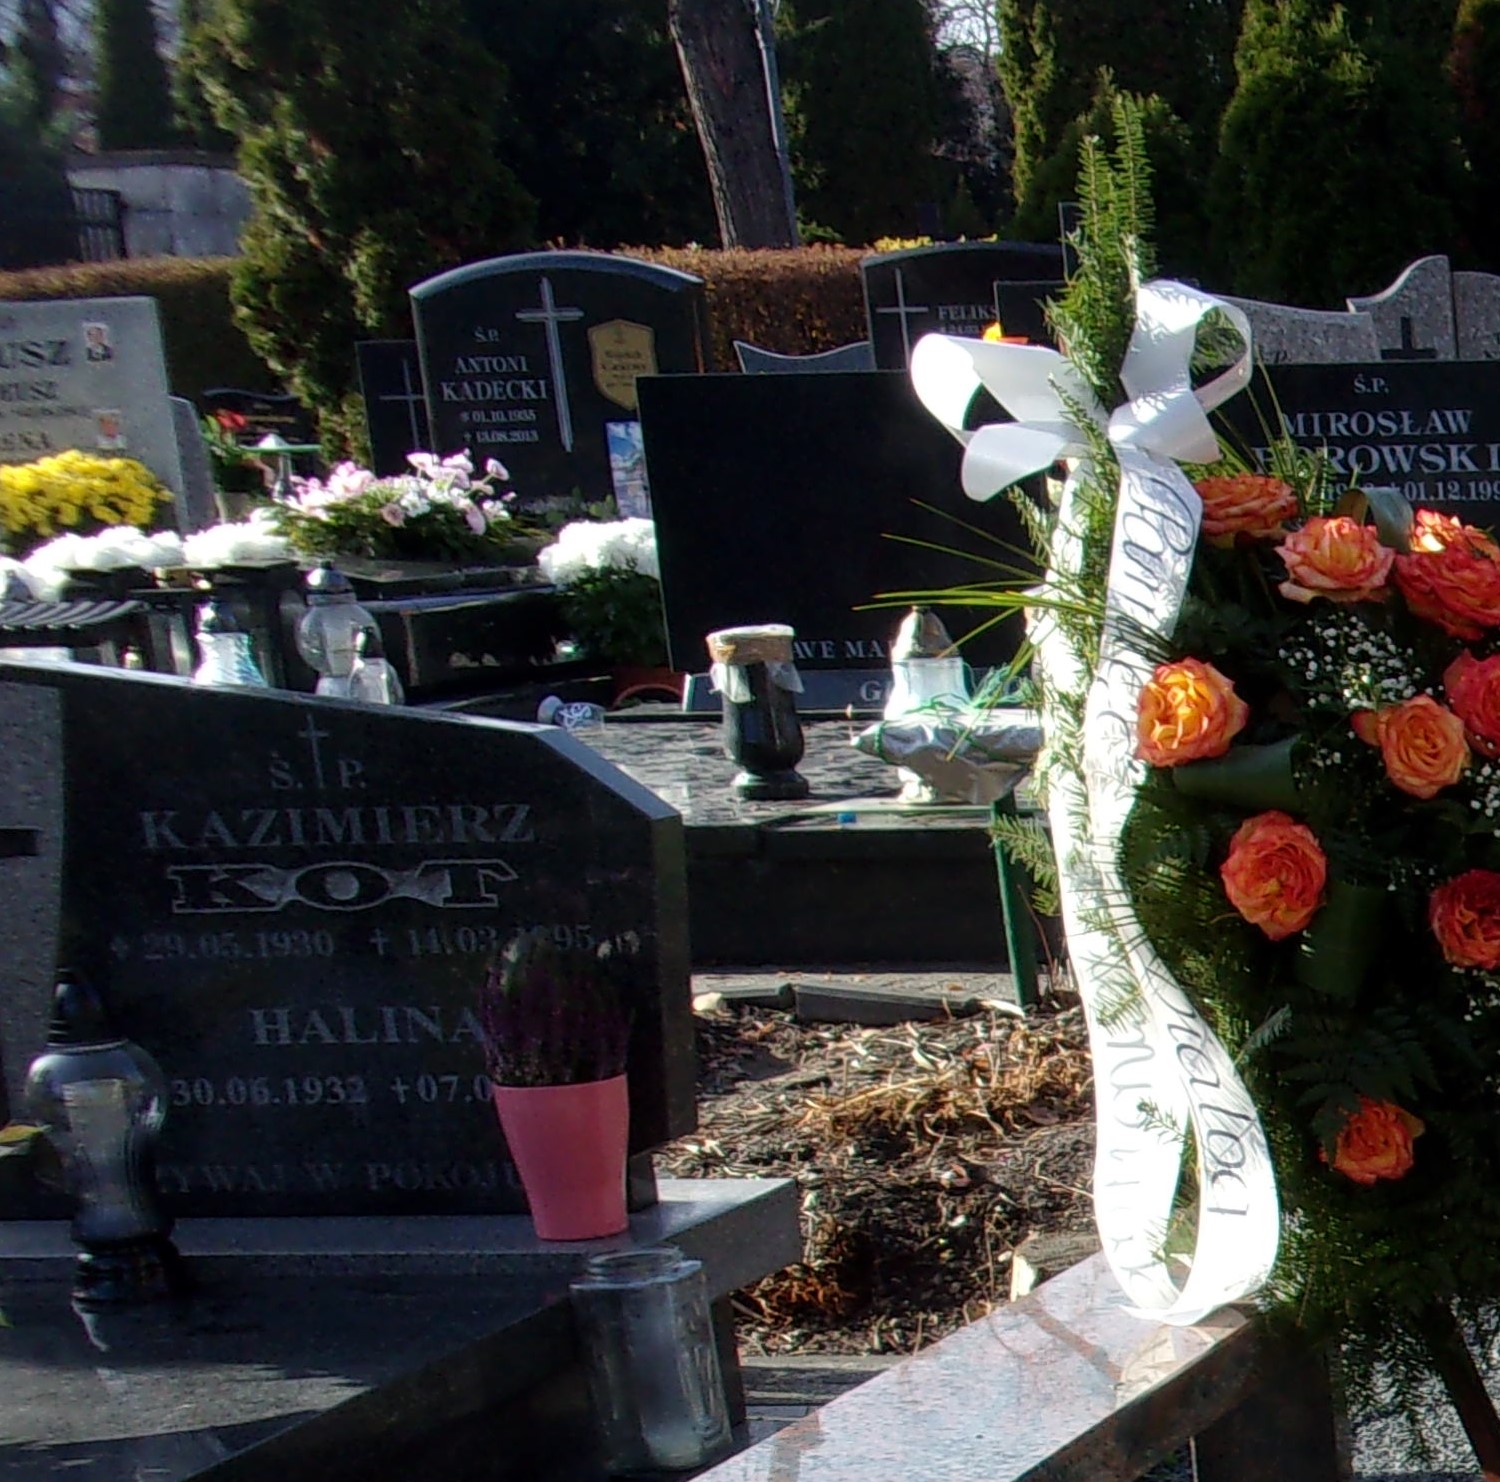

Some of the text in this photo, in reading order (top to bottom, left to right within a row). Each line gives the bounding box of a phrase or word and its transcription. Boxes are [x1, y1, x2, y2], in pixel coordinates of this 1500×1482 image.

[455, 356, 529, 374] ANTONI
[440, 380, 549, 402] KADECKI
[1281, 408, 1473, 438] MIROSŁAW
[138, 803, 535, 850] KAZIMIERZ
[166, 858, 520, 914] KOT
[248, 1006, 488, 1047] HALINA
